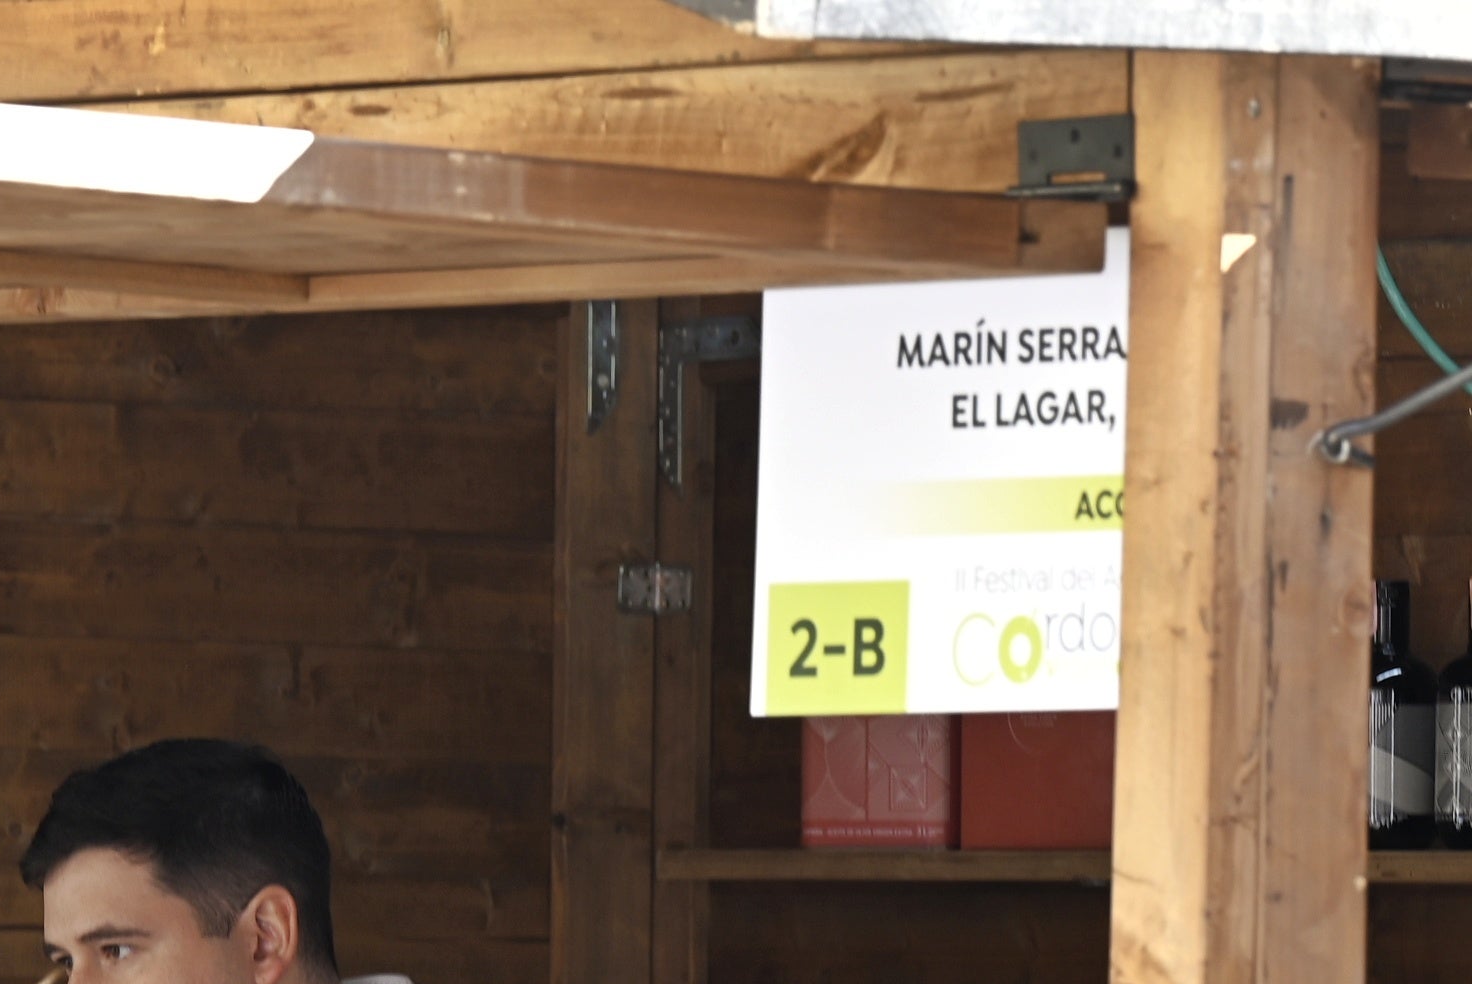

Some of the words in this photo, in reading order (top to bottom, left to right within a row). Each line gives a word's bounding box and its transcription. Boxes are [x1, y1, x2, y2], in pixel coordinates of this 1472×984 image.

[897, 317, 1008, 368] MARÍN
[952, 394, 987, 429] EL
[995, 389, 1116, 432] LAGAR,
[974, 564, 1053, 593] Festival
[1061, 564, 1095, 591] del
[789, 617, 886, 677] 2-B
